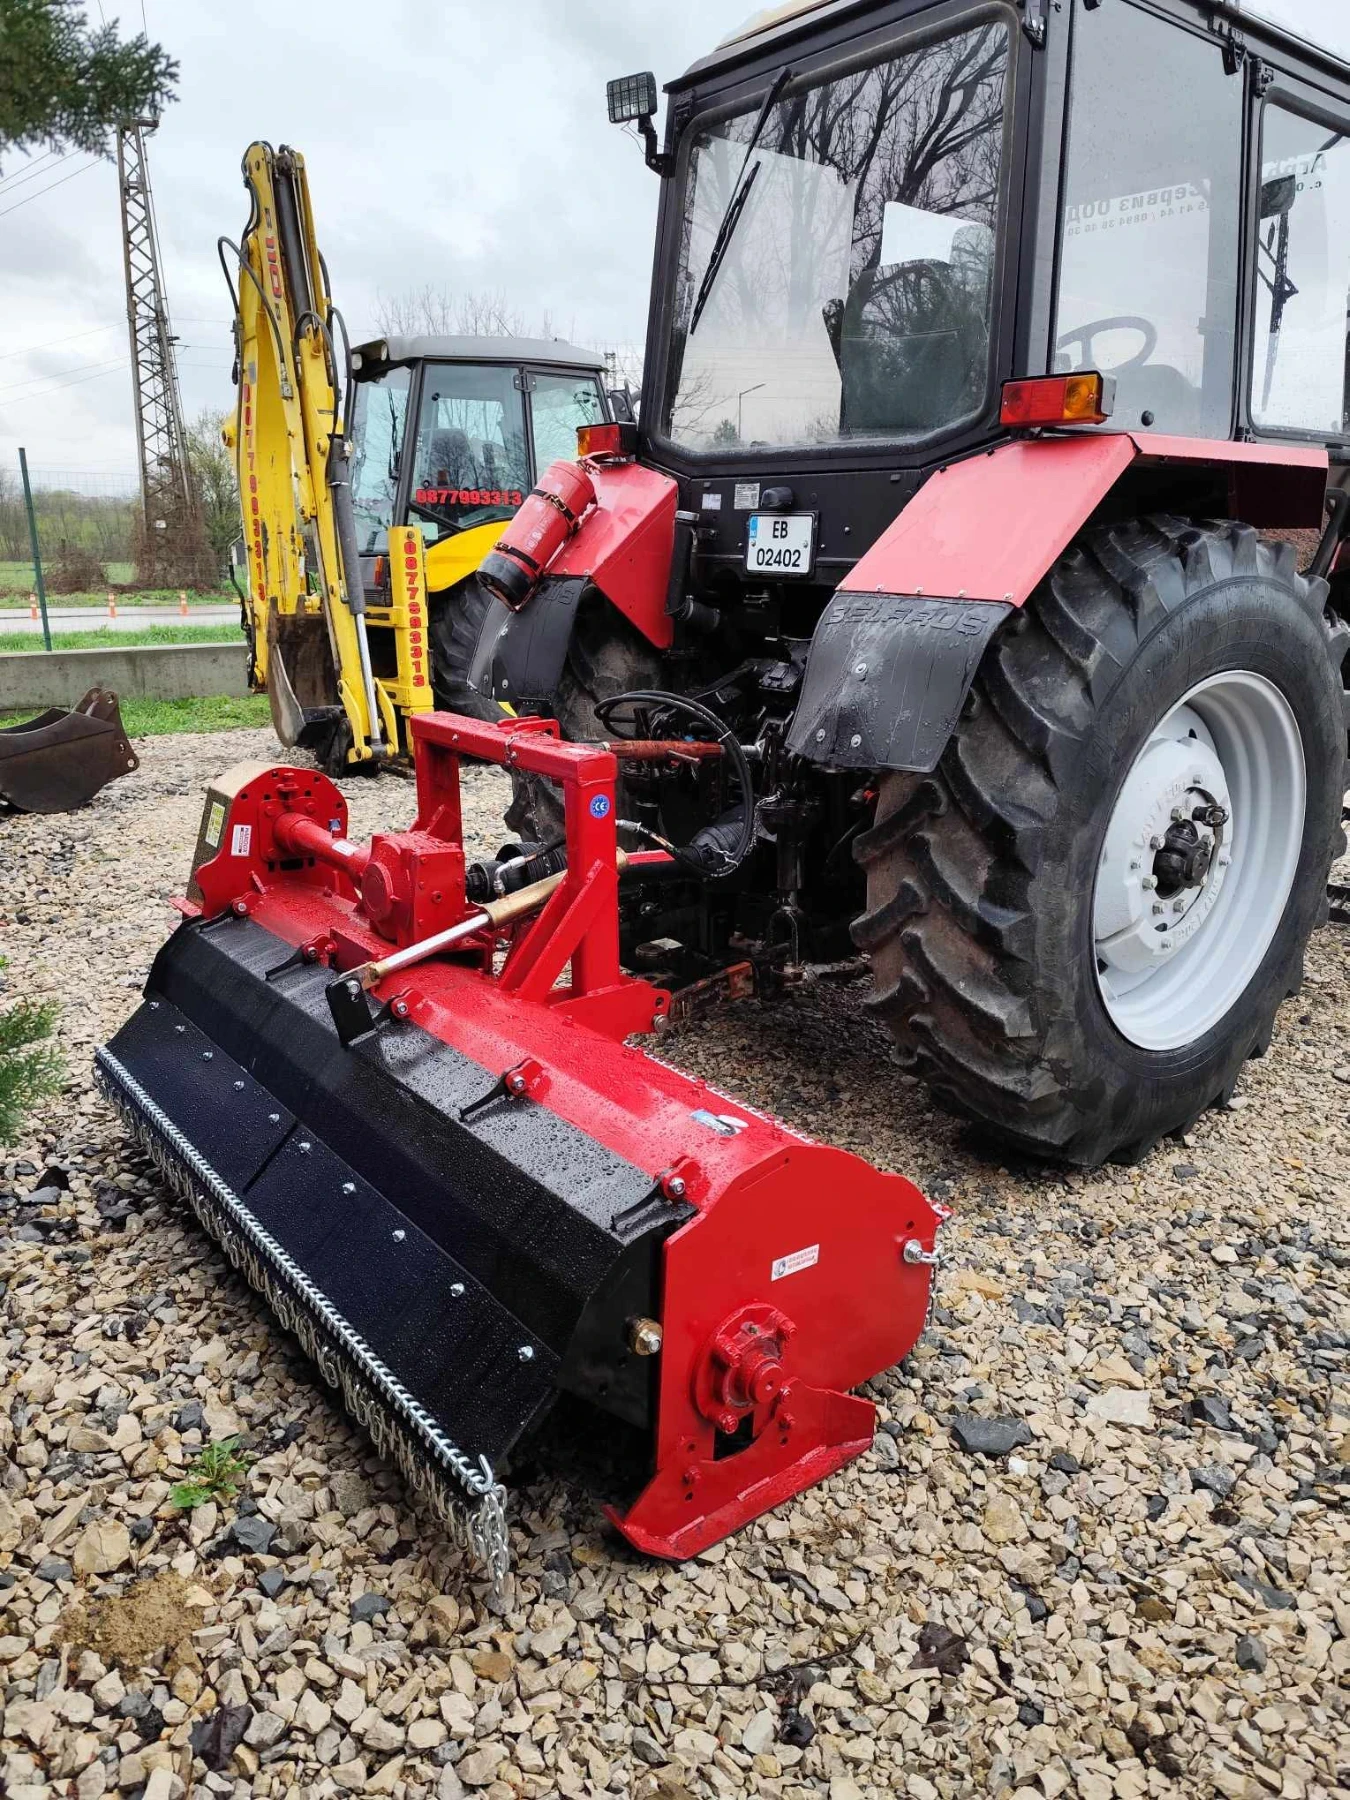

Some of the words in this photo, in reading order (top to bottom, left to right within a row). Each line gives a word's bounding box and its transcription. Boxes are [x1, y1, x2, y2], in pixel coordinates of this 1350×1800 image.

[415, 488, 523, 506] 0877993313
[772, 520, 788, 539] EB
[756, 548, 802, 568] 02402
[403, 540, 426, 688] 0877993313
